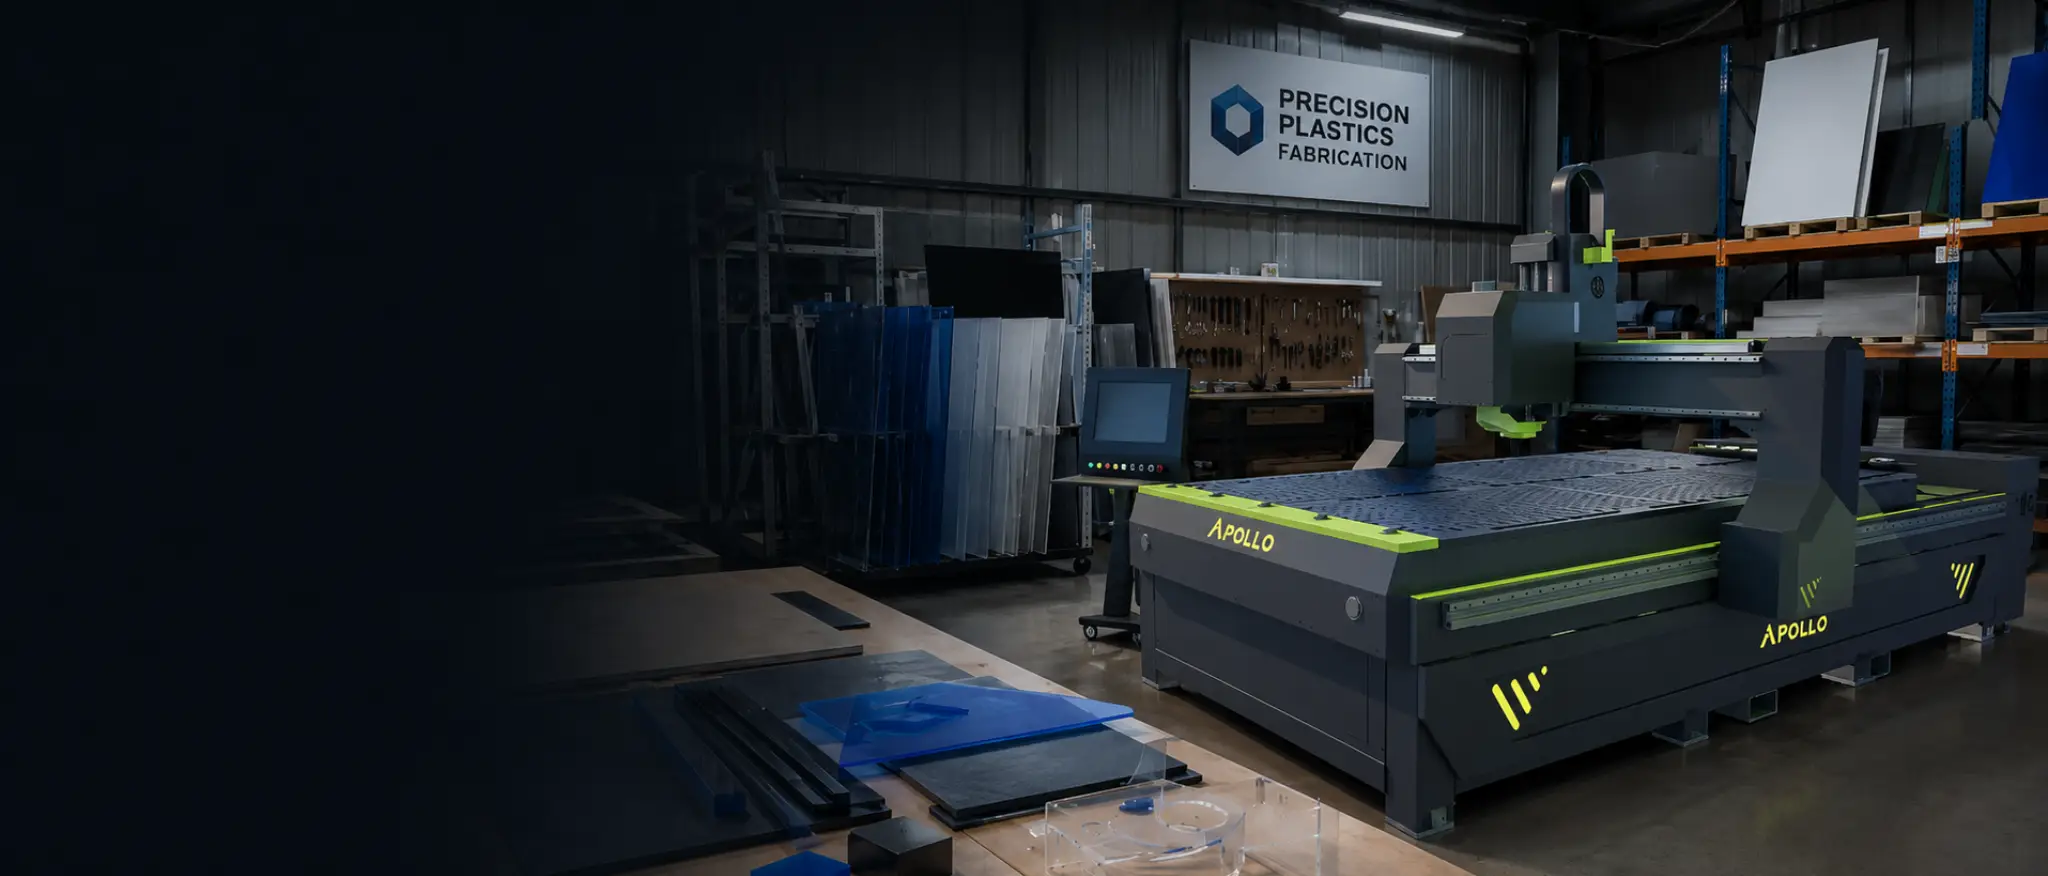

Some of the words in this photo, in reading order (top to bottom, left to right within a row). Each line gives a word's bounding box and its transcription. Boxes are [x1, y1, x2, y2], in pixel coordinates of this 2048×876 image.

[1279, 88, 1409, 124] PRECISION
[1279, 114, 1394, 146] PLASTICS
[1278, 143, 1407, 171] FABRICATION
[1207, 517, 1275, 552] APOLLO
[1760, 615, 1828, 649] APOLLO
